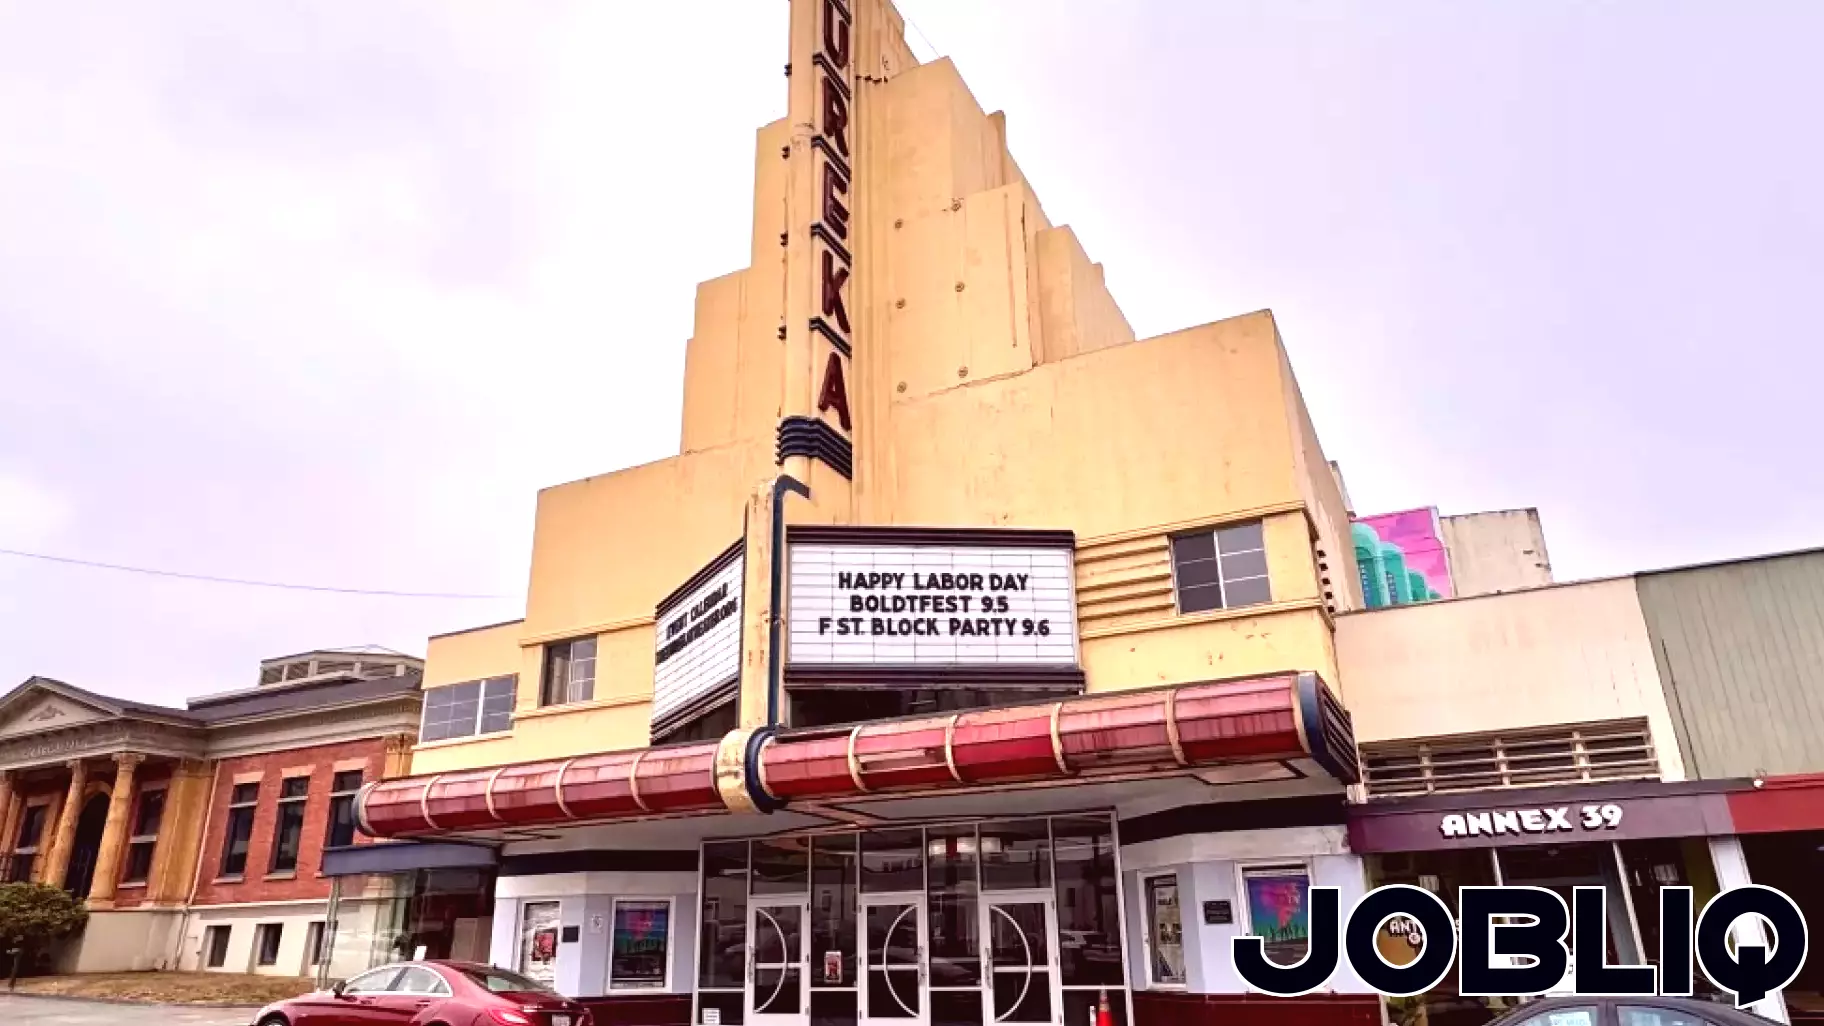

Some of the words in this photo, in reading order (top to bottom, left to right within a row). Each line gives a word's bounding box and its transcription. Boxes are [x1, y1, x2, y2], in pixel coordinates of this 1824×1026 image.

[838, 571, 905, 590] HAPPY
[913, 572, 983, 591] LABOR
[989, 573, 1029, 591] DAY
[849, 594, 972, 613] BOLDTFEST
[980, 595, 1009, 614] 9.5
[818, 617, 832, 636] F
[836, 617, 865, 636] ST.
[870, 617, 940, 636] BLOCK
[949, 617, 1018, 637] PARTY
[1022, 618, 1051, 637] 9.6
[1439, 806, 1573, 839] ANNEX
[1580, 803, 1624, 832] 39
